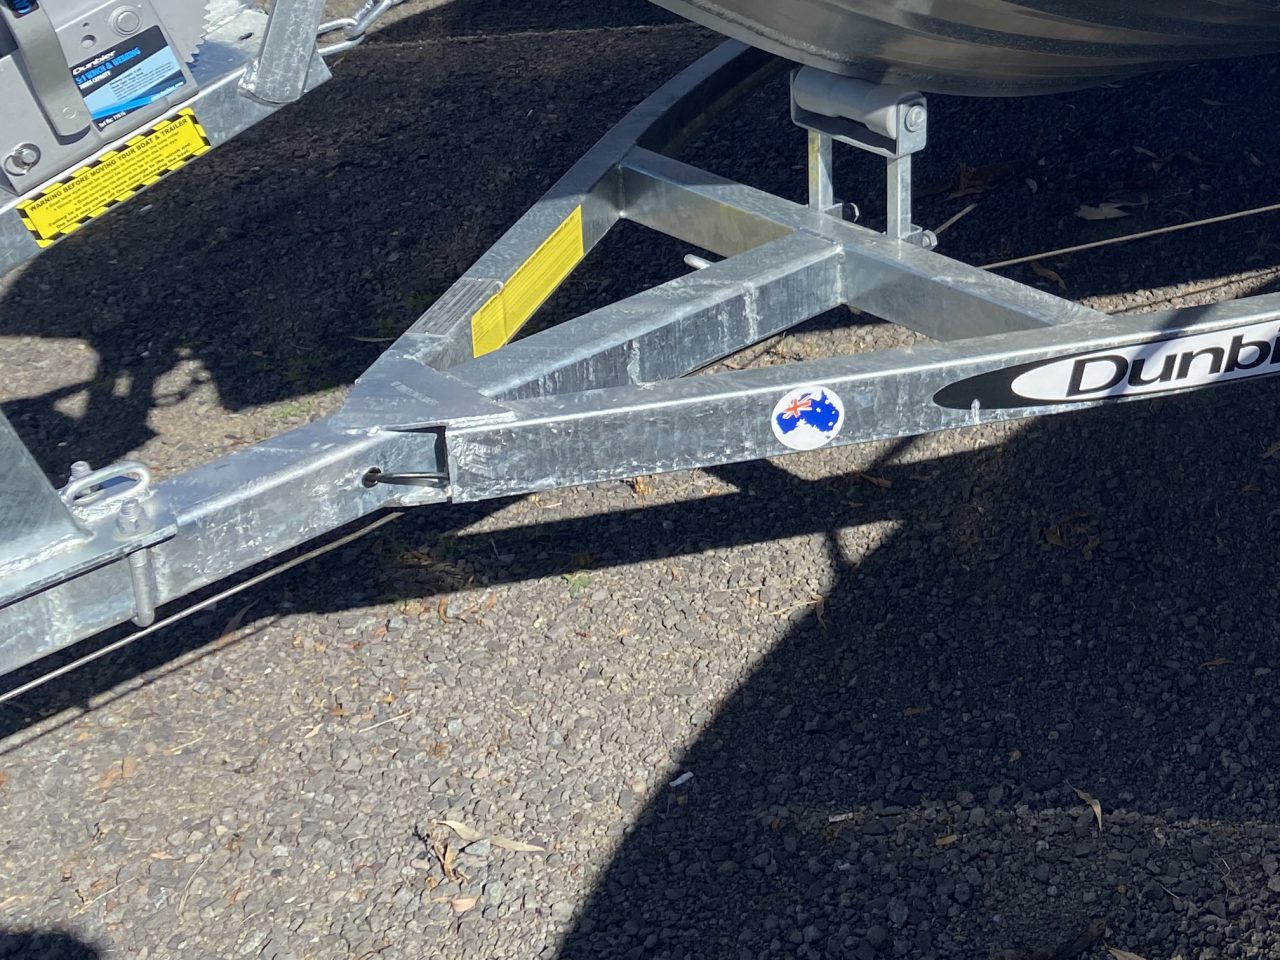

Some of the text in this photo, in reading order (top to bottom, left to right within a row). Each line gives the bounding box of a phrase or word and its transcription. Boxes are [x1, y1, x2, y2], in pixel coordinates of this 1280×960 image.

[72, 50, 116, 75] Dunbier
[28, 189, 62, 212] WARNING
[61, 173, 89, 193] BEFORE
[89, 158, 117, 177] MOVING
[116, 147, 136, 162] YOUR
[135, 137, 154, 151] BOAT
[159, 117, 188, 137] TRAILER
